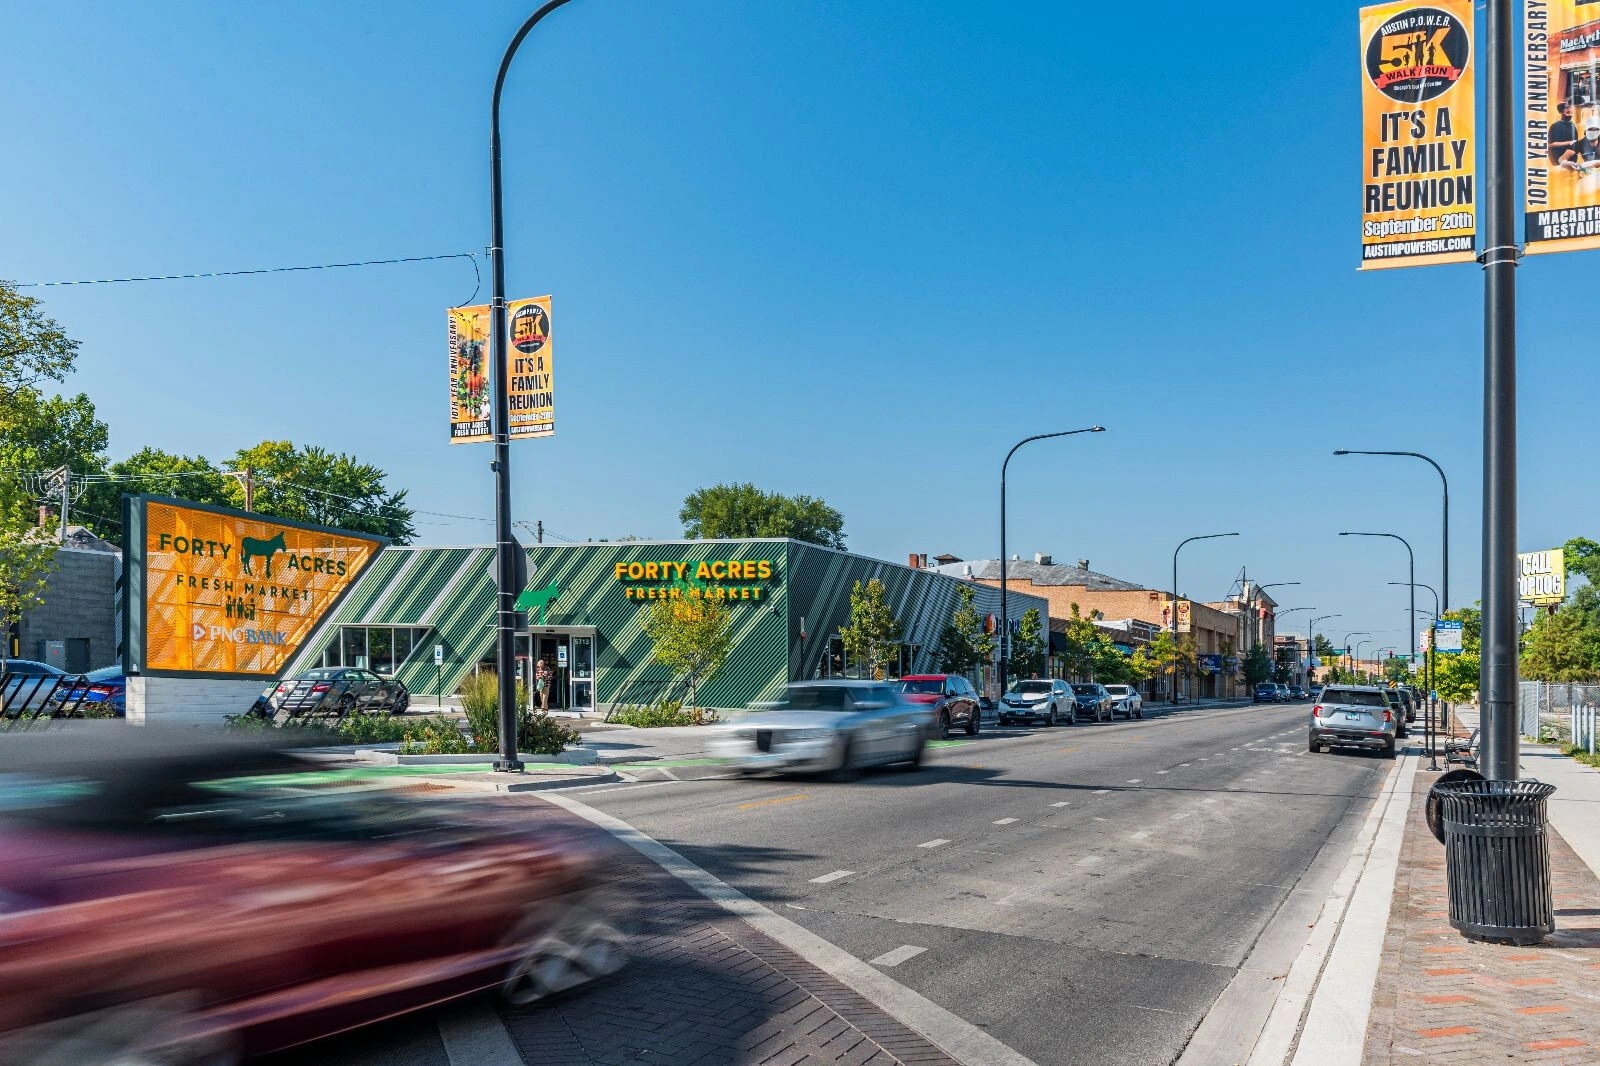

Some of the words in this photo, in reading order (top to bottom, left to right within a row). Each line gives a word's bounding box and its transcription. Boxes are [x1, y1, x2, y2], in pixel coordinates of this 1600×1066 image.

[1380, 19, 1409, 37] AUSTIN
[1379, 27, 1452, 74] 5K
[1528, 0, 1547, 113] ANNIVERSARY
[1385, 68, 1416, 81] WALK
[1424, 66, 1448, 75] RUN
[1381, 109, 1426, 142] IT'S
[1435, 107, 1451, 137] A
[1528, 119, 1547, 160] YEAR
[1372, 140, 1467, 177] FAMILY
[1365, 175, 1473, 213] REUNION
[1528, 167, 1547, 206] 10TH
[1364, 216, 1439, 238] September
[1441, 211, 1474, 230] 20th
[1364, 236, 1472, 259] AUSTINPOWER5K.COM
[515, 358, 534, 373] IT'S
[538, 356, 544, 371] A
[511, 374, 549, 391] FAMILY
[509, 392, 552, 410] REUNION
[160, 533, 231, 560] FORTY
[287, 553, 346, 577] ACRES
[1522, 551, 1552, 576] CALL
[615, 561, 688, 580] FORTY
[695, 560, 772, 579] ACRES
[176, 574, 233, 592] FRESH
[244, 583, 309, 601] MARKET
[625, 586, 681, 599] FRESH
[689, 586, 762, 599] MARKET
